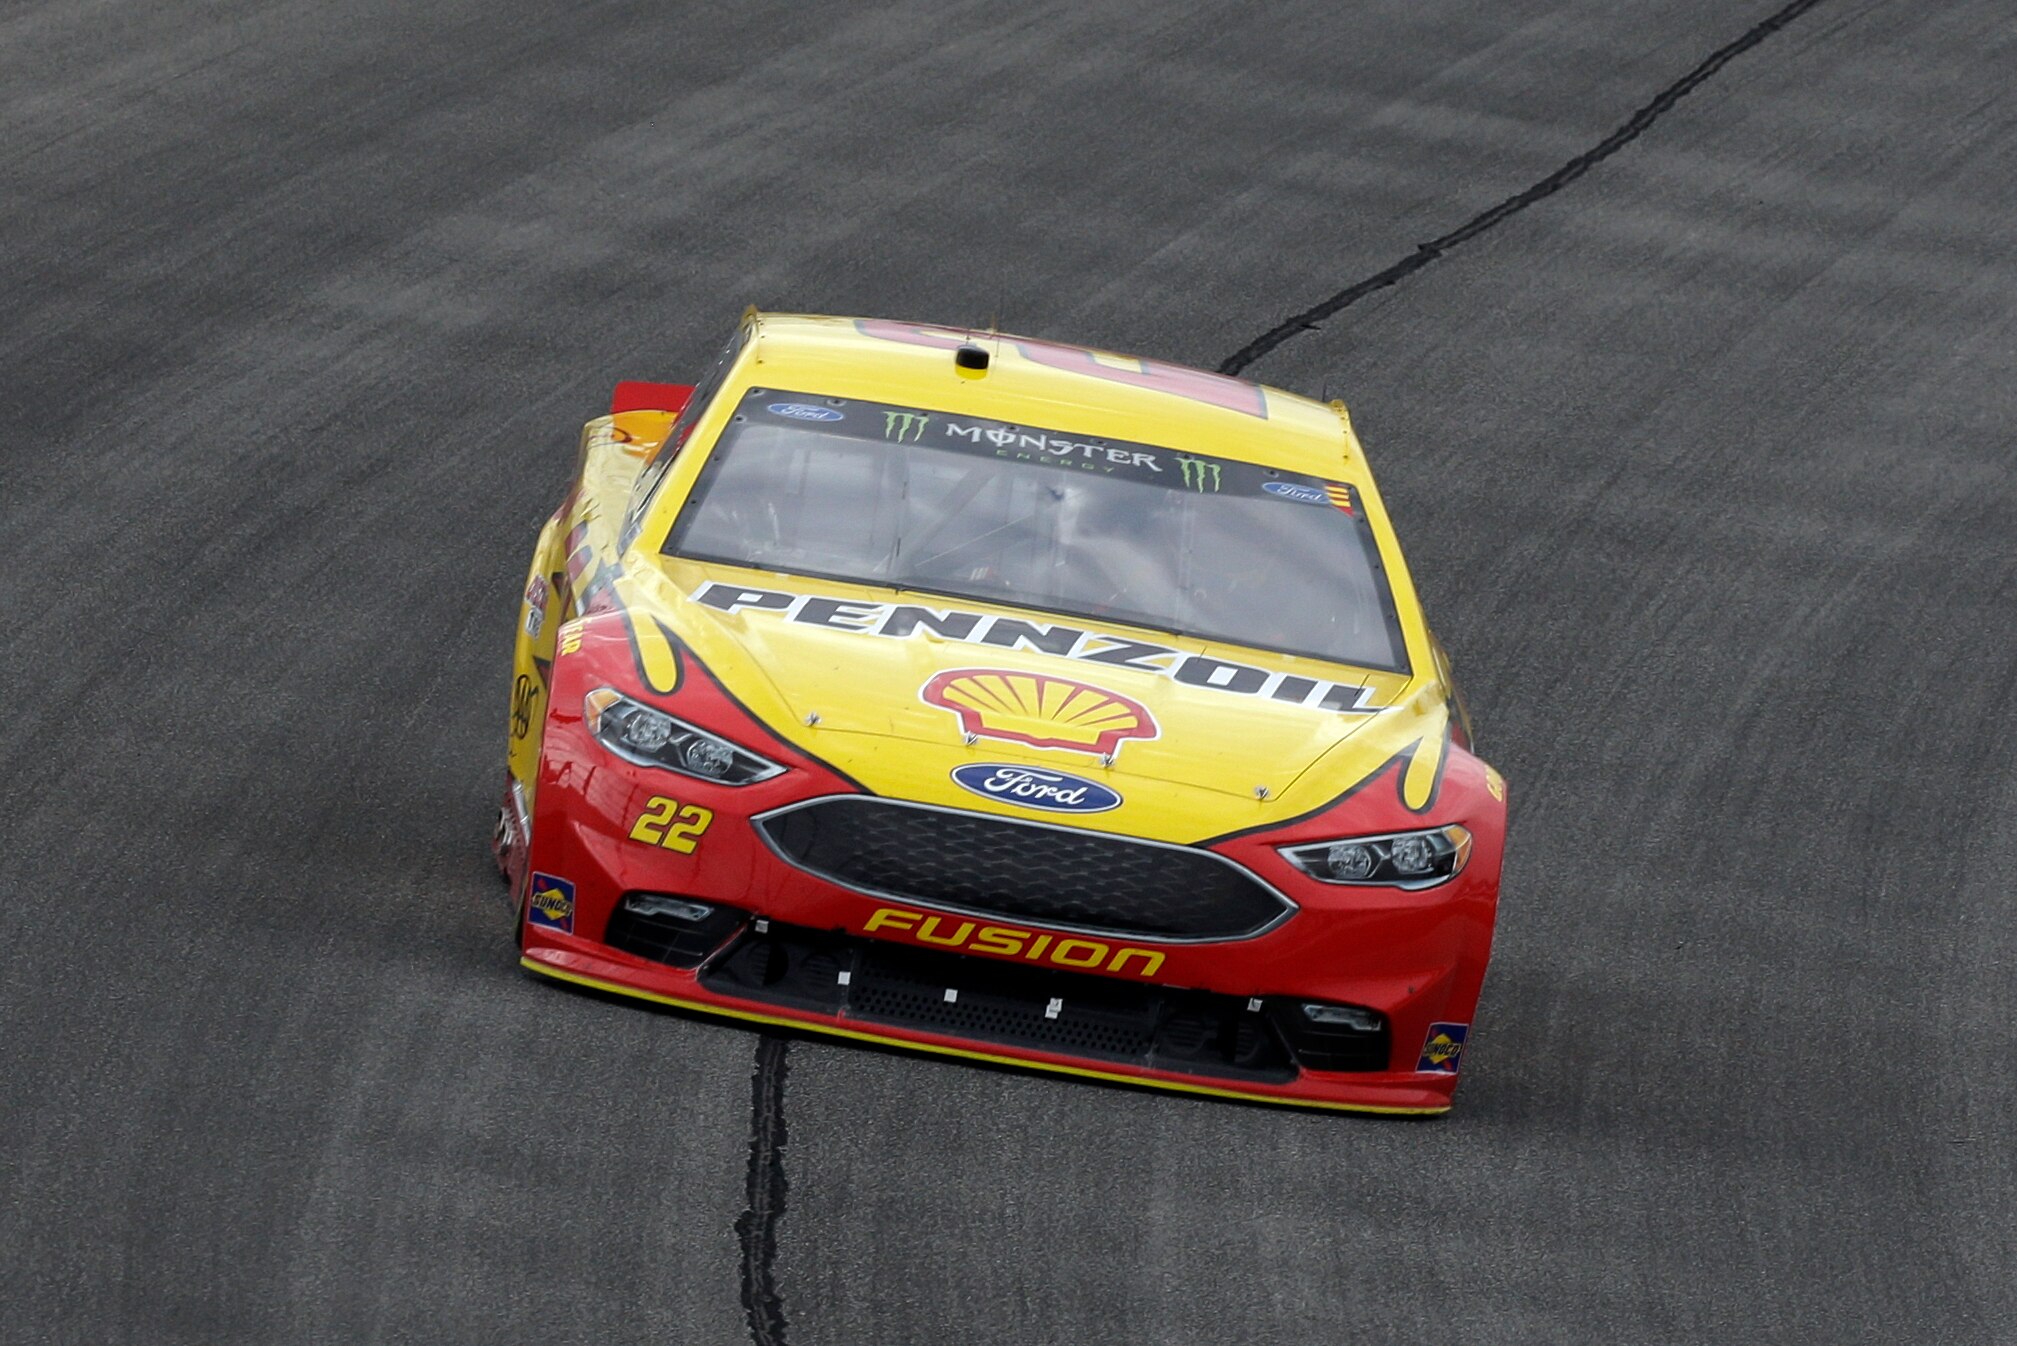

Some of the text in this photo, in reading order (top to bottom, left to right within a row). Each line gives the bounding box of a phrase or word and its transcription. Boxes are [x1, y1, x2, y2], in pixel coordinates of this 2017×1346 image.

[945, 423, 1163, 472] MONSTER
[996, 449, 1114, 473] ENERGY
[687, 580, 1403, 716] PENNZOIL
[983, 768, 1088, 805] Ford
[629, 795, 715, 855] 22
[531, 891, 574, 918] SUNOCO
[863, 908, 1166, 977] FUSION
